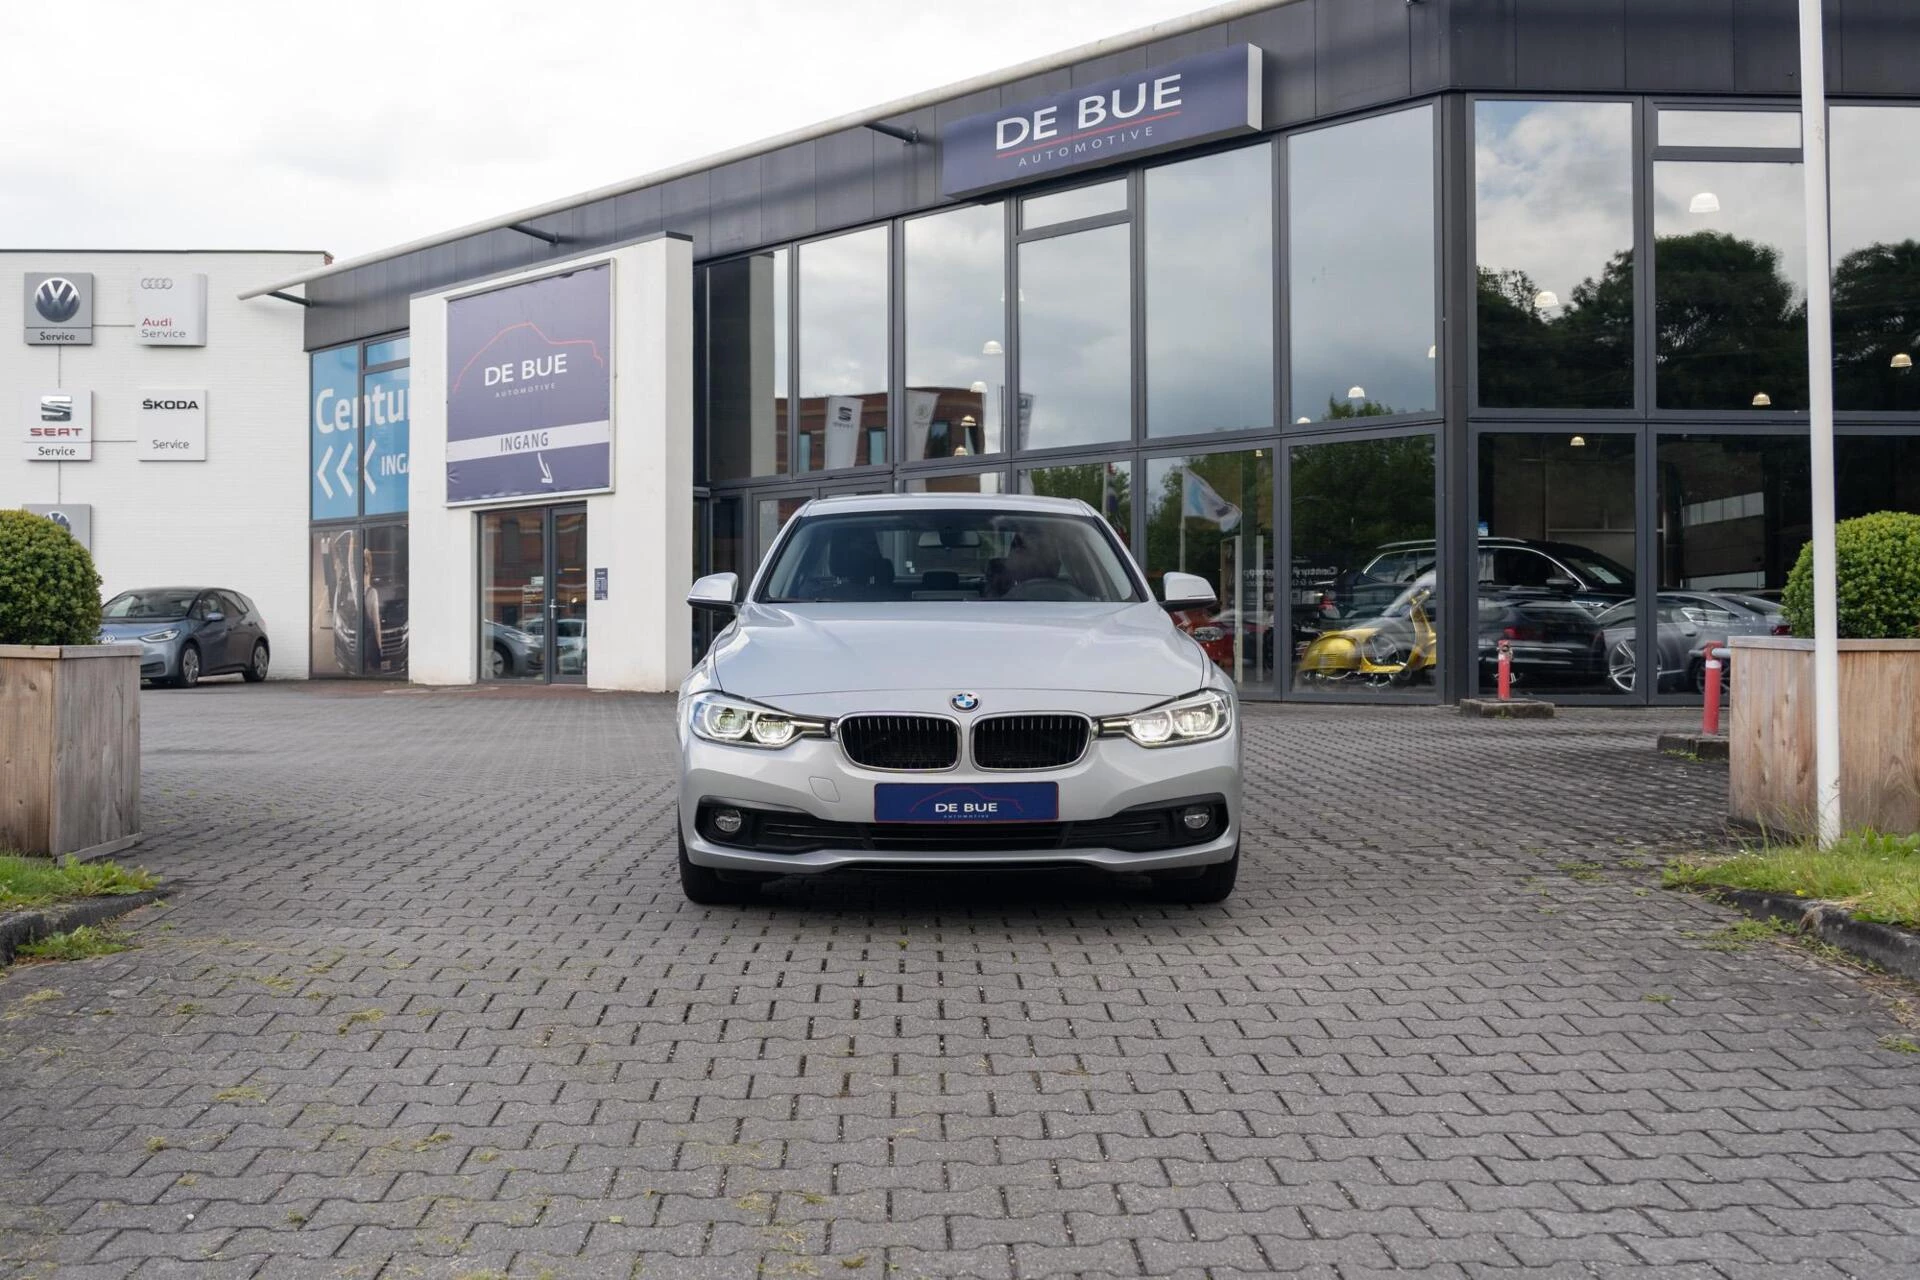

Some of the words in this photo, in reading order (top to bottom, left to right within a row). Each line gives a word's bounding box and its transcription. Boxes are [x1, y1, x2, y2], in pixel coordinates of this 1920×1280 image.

[996, 106, 1057, 150] DE
[1078, 73, 1182, 129] BUE
[1018, 126, 1154, 167] AUTOMOTIVE
[142, 318, 172, 327] Audi
[40, 332, 75, 341] Service
[141, 329, 186, 338] Service
[485, 363, 514, 386] DE
[522, 353, 567, 380] BUE
[495, 382, 556, 398] AUTOMOTIVE
[142, 399, 199, 410] ŠKODA
[316, 384, 410, 434] Centu
[30, 428, 83, 437] SEAT
[152, 439, 189, 450] Service
[500, 432, 549, 452] INGANG
[38, 446, 76, 457] Service
[381, 452, 410, 477] ING
[935, 803, 958, 813] DE
[964, 803, 998, 813] BUE
